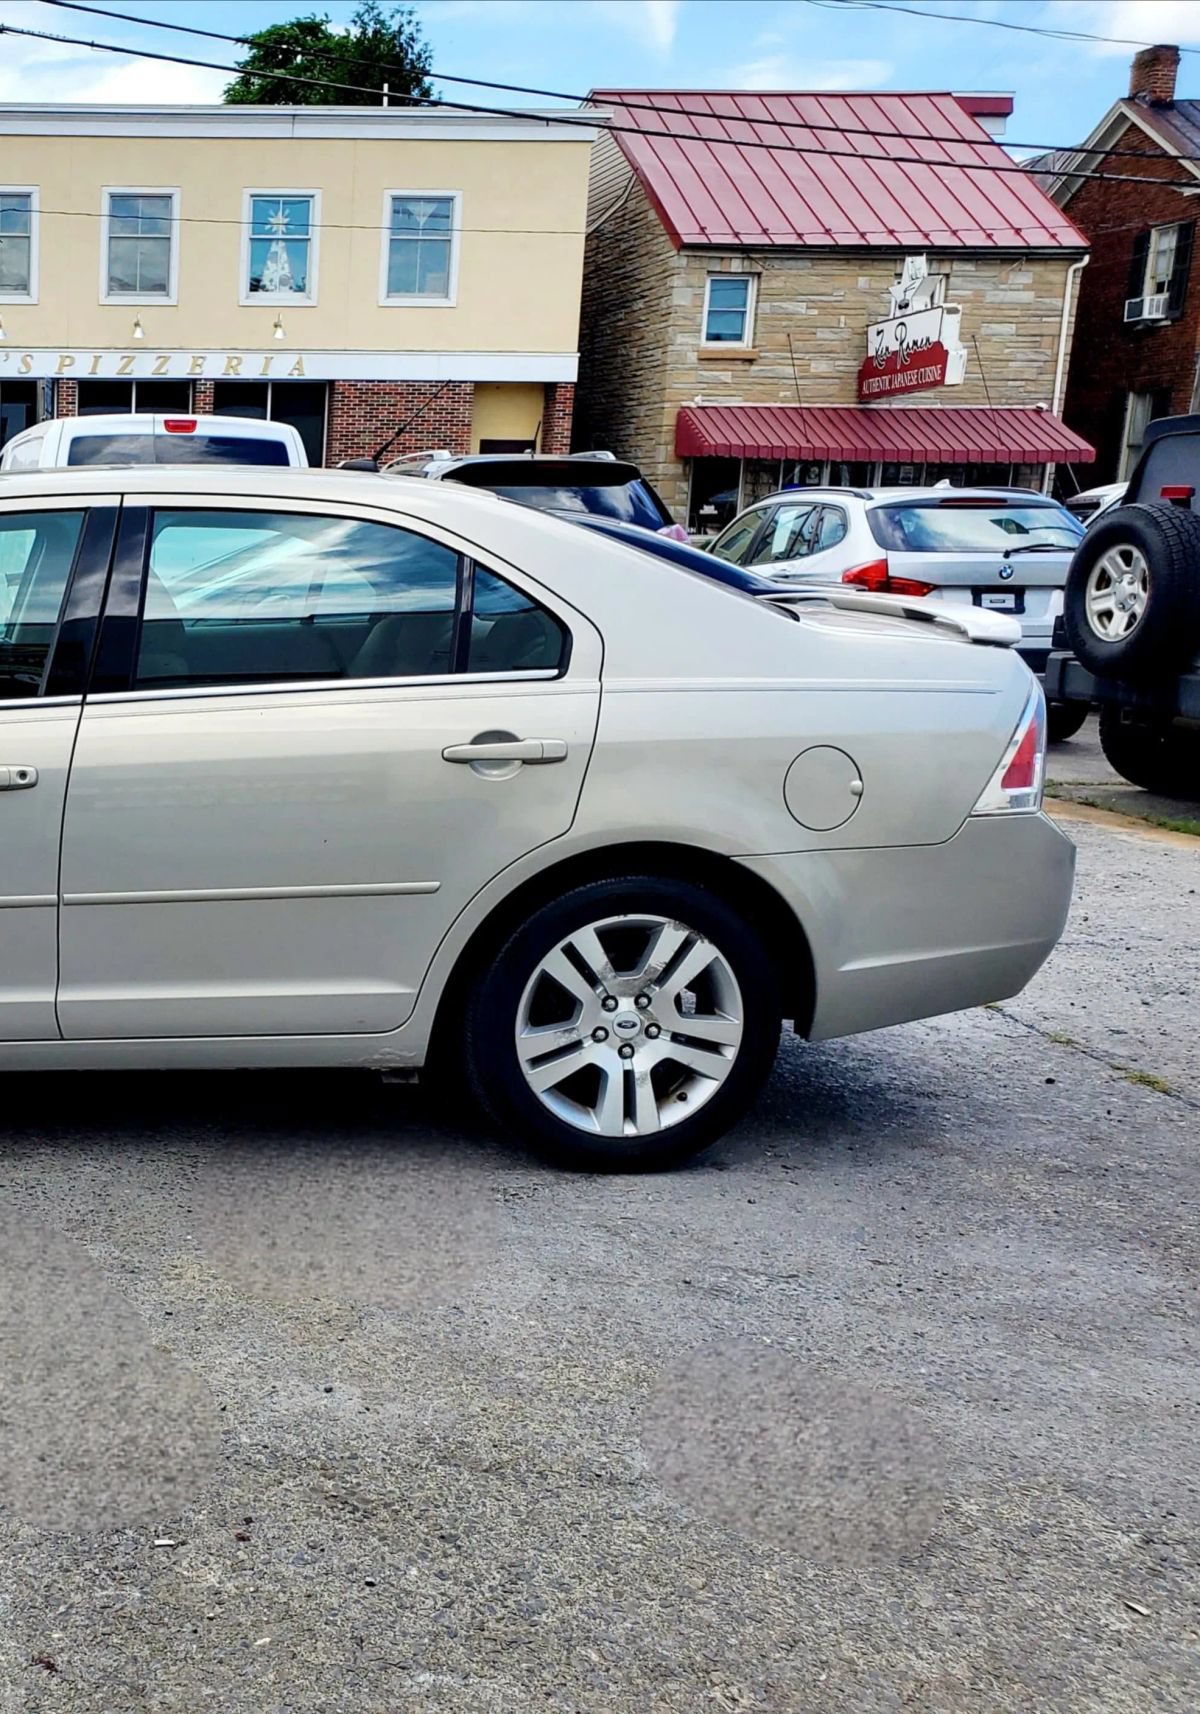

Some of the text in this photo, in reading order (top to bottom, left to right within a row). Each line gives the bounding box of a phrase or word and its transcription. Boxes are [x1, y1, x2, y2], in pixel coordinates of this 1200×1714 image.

[895, 321, 932, 370] Ramen
[54, 354, 306, 376] PIZZERIA
[862, 365, 942, 394] AUTHENTIC JAPANESE CUISINE
